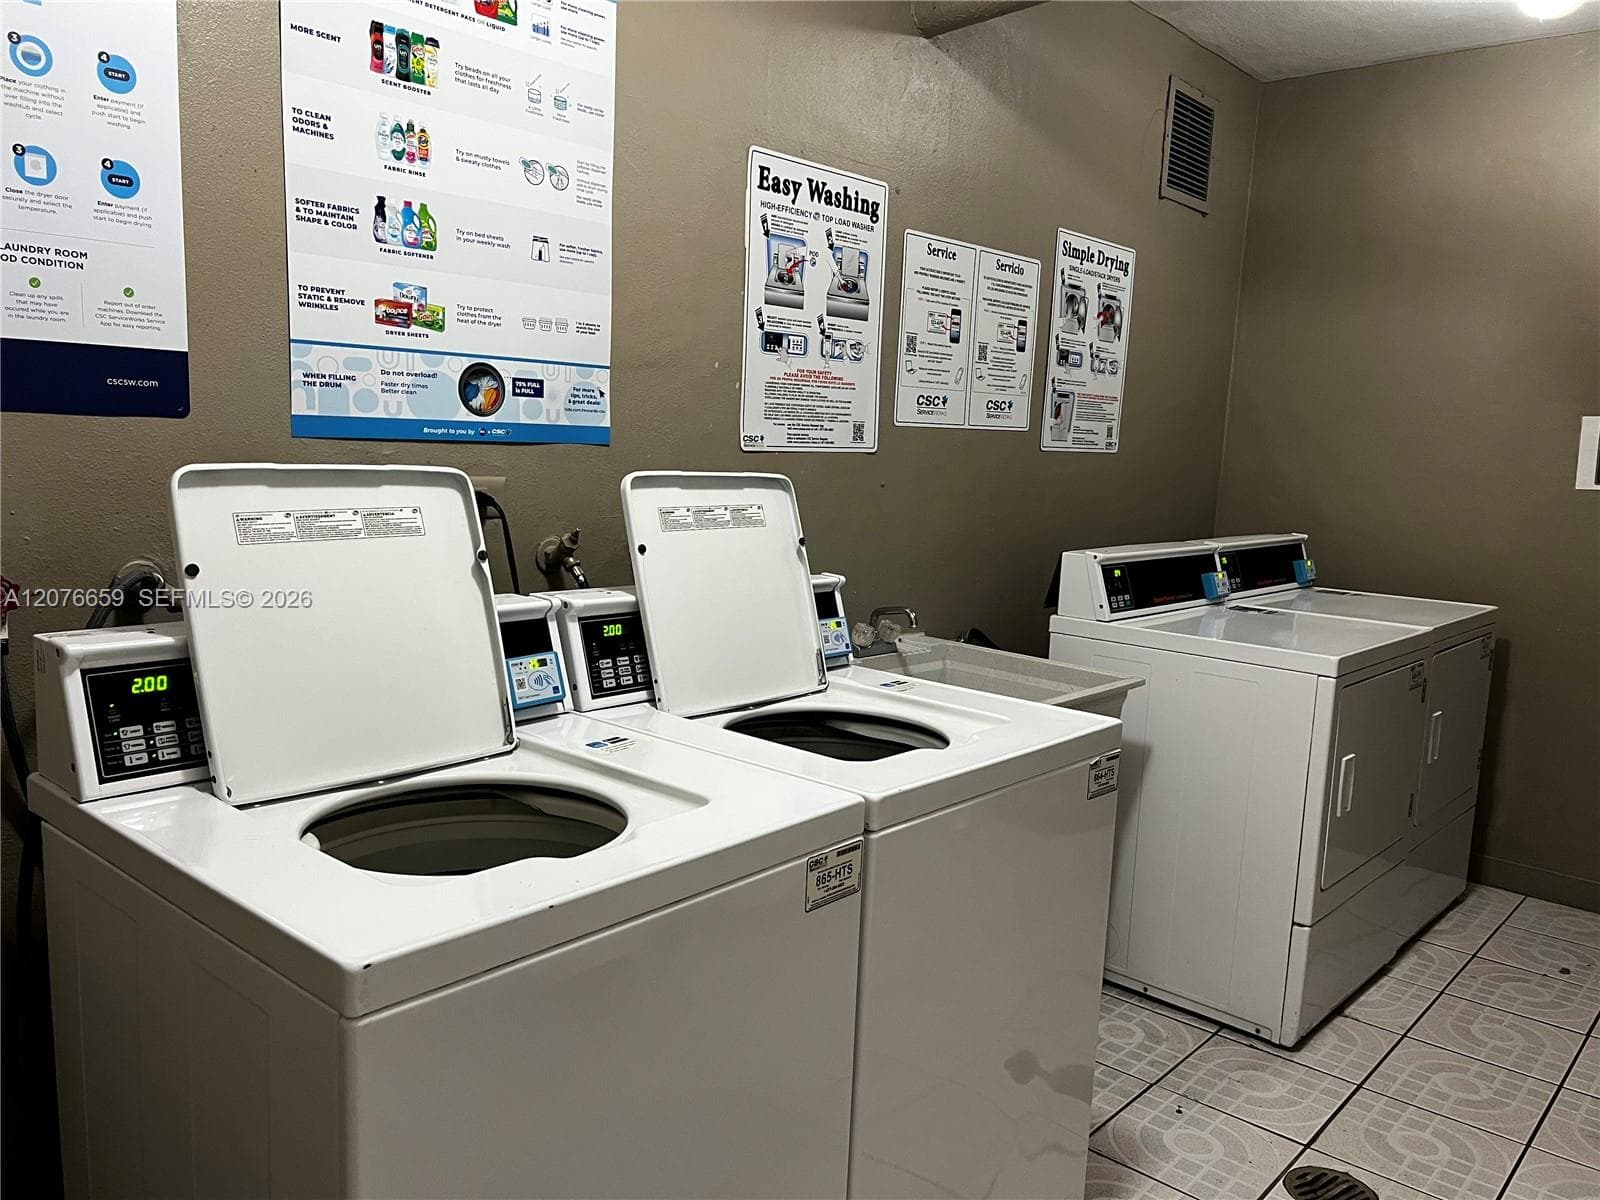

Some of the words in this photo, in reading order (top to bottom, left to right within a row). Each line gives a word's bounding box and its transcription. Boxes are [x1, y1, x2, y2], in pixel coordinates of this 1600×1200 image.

[425, 2, 459, 16] DETERGENT
[461, 13, 476, 22] PACS
[486, 22, 506, 31] LIQUID
[10, 33, 18, 42] 3
[290, 23, 313, 35] MORE
[316, 30, 340, 42] SCENT
[455, 62, 463, 70] Try
[464, 65, 481, 74] beads
[108, 71, 127, 79] START
[454, 70, 475, 79] clothes
[485, 78, 511, 89] freshness
[381, 78, 400, 87] SCENT
[402, 84, 430, 95] BOOSTER
[304, 110, 331, 121] CLEAN
[292, 116, 320, 128] ODORS
[292, 125, 333, 139] MACHINES
[104, 160, 111, 168] 4
[460, 158, 480, 166] sweaty
[384, 164, 406, 173] FABRIC
[112, 177, 129, 185] START
[758, 165, 802, 205] Easy
[806, 178, 880, 224] Washing
[295, 197, 324, 208] SOFTER
[327, 203, 359, 214] FABRICS
[760, 200, 811, 218] HIGH-EFFICIENCY
[295, 214, 321, 224] SHAPE
[331, 220, 357, 229] COLOR
[315, 210, 353, 221] MAINTAIN
[822, 214, 833, 222] TOP
[834, 217, 850, 227] LOAD
[851, 221, 874, 232] WASHER
[54, 248, 87, 259] ROOM
[403, 251, 433, 259] SOFTENER
[926, 243, 956, 260] Service
[1062, 240, 1095, 265] Simple
[1097, 250, 1130, 277] Drying
[995, 259, 1024, 275] Servicio
[310, 286, 344, 295] PREVENT
[298, 292, 324, 301] STATIC
[333, 296, 364, 305] REMOVE
[298, 301, 338, 310] WRINKLES
[106, 378, 158, 386] cscsw.com
[916, 394, 940, 406] CSC
[986, 399, 1006, 410] CSC
[603, 624, 622, 636] 2.00
[132, 675, 167, 694] 2.00
[816, 863, 853, 886] 865-HTS
